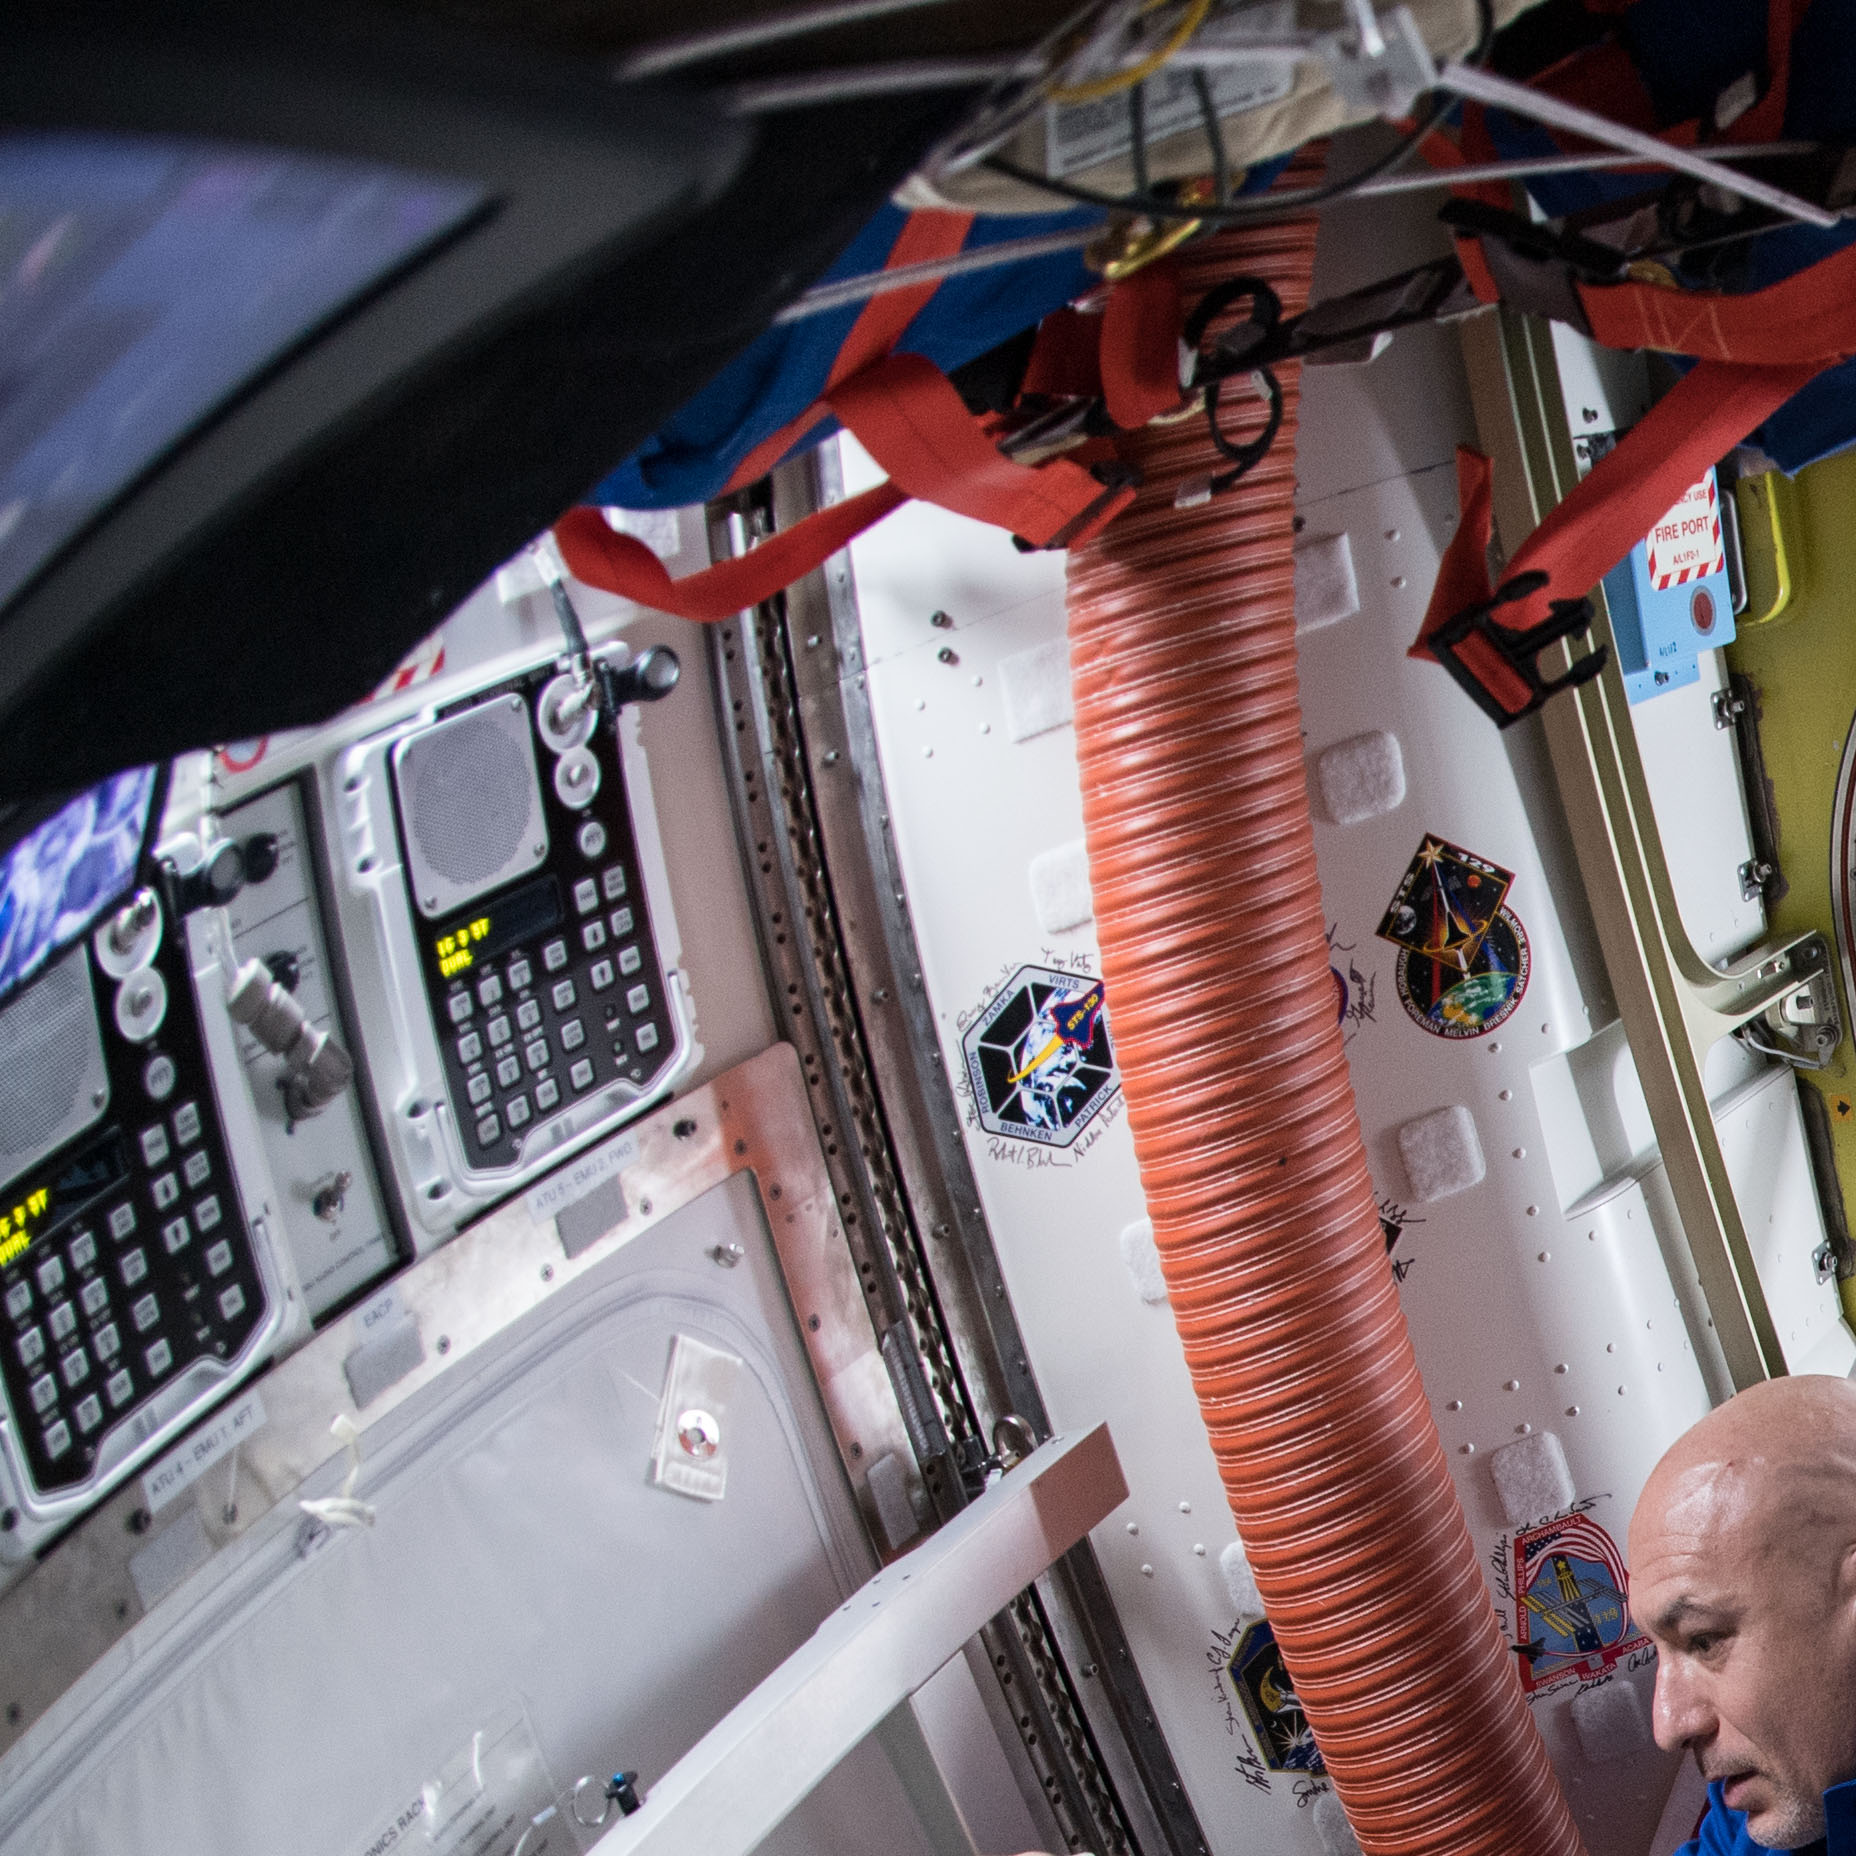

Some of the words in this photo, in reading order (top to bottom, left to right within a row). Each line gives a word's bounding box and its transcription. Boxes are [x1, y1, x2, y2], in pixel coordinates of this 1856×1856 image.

[1655, 521, 1679, 543] FIRE
[1682, 516, 1709, 535] PORT
[1457, 852, 1496, 873] 129
[1049, 975, 1080, 989] VIRTS
[982, 988, 1015, 1026] ZAMKA
[1066, 993, 1099, 1030] STS-130
[1403, 999, 1441, 1034] FOREMAN
[1444, 1026, 1480, 1038] MELVIN
[969, 1051, 990, 1114] ROBINSON
[1074, 1087, 1113, 1128] PATRICK
[1000, 1121, 1053, 1141] BEHNKEN
[534, 1188, 557, 1211] ATU
[606, 1140, 634, 1164] FWD
[362, 1298, 394, 1329] EACP
[149, 1467, 177, 1499] ATU
[232, 1407, 256, 1430] AFT
[1521, 1516, 1583, 1546] ARCHAMBAULT
[1516, 1557, 1526, 1595] PHILLIPS
[1518, 1605, 1528, 1640] ARNOLD
[1622, 1638, 1652, 1655] ACABA
[1535, 1667, 1577, 1689] SWANSON
[1581, 1661, 1617, 1681] WAKATA
